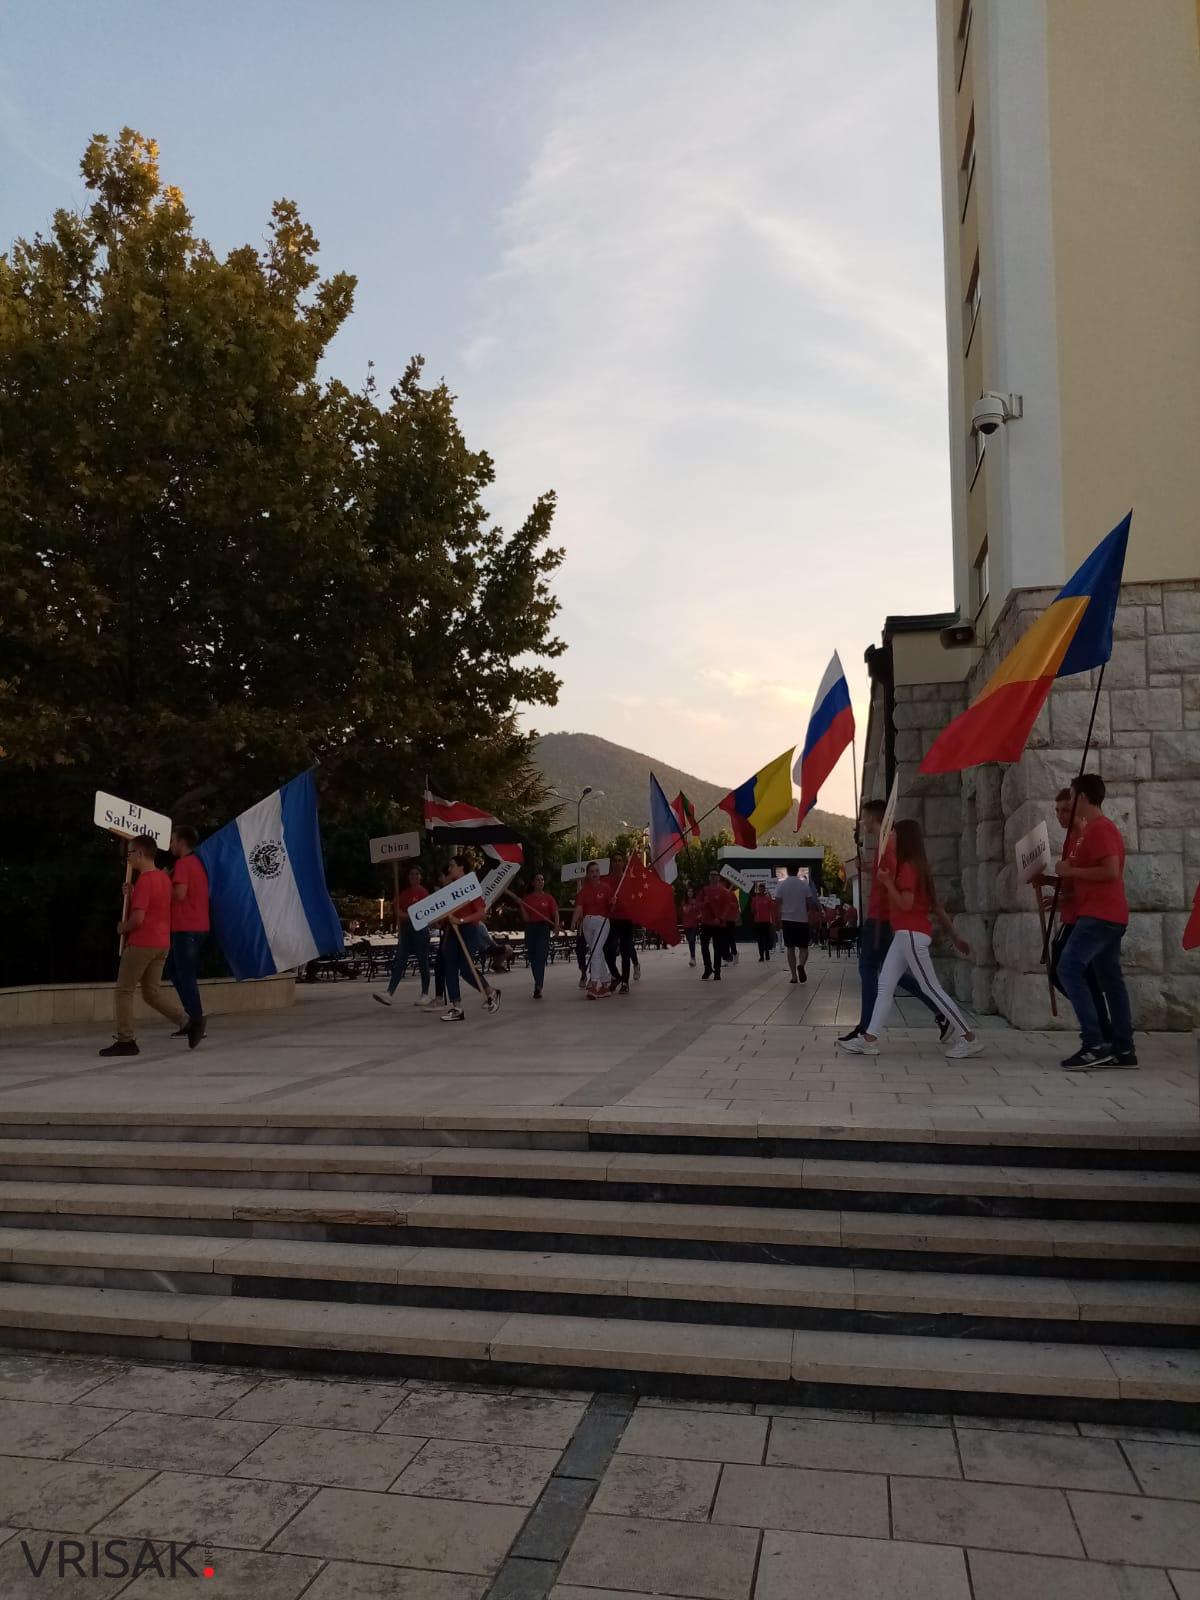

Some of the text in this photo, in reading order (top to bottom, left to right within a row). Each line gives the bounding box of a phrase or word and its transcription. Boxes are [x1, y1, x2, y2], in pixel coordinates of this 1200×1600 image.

[104, 809, 161, 840] Salvador
[128, 803, 142, 819] El
[380, 841, 409, 854] China
[484, 863, 513, 896] olombia
[415, 882, 477, 921] Costa Rica
